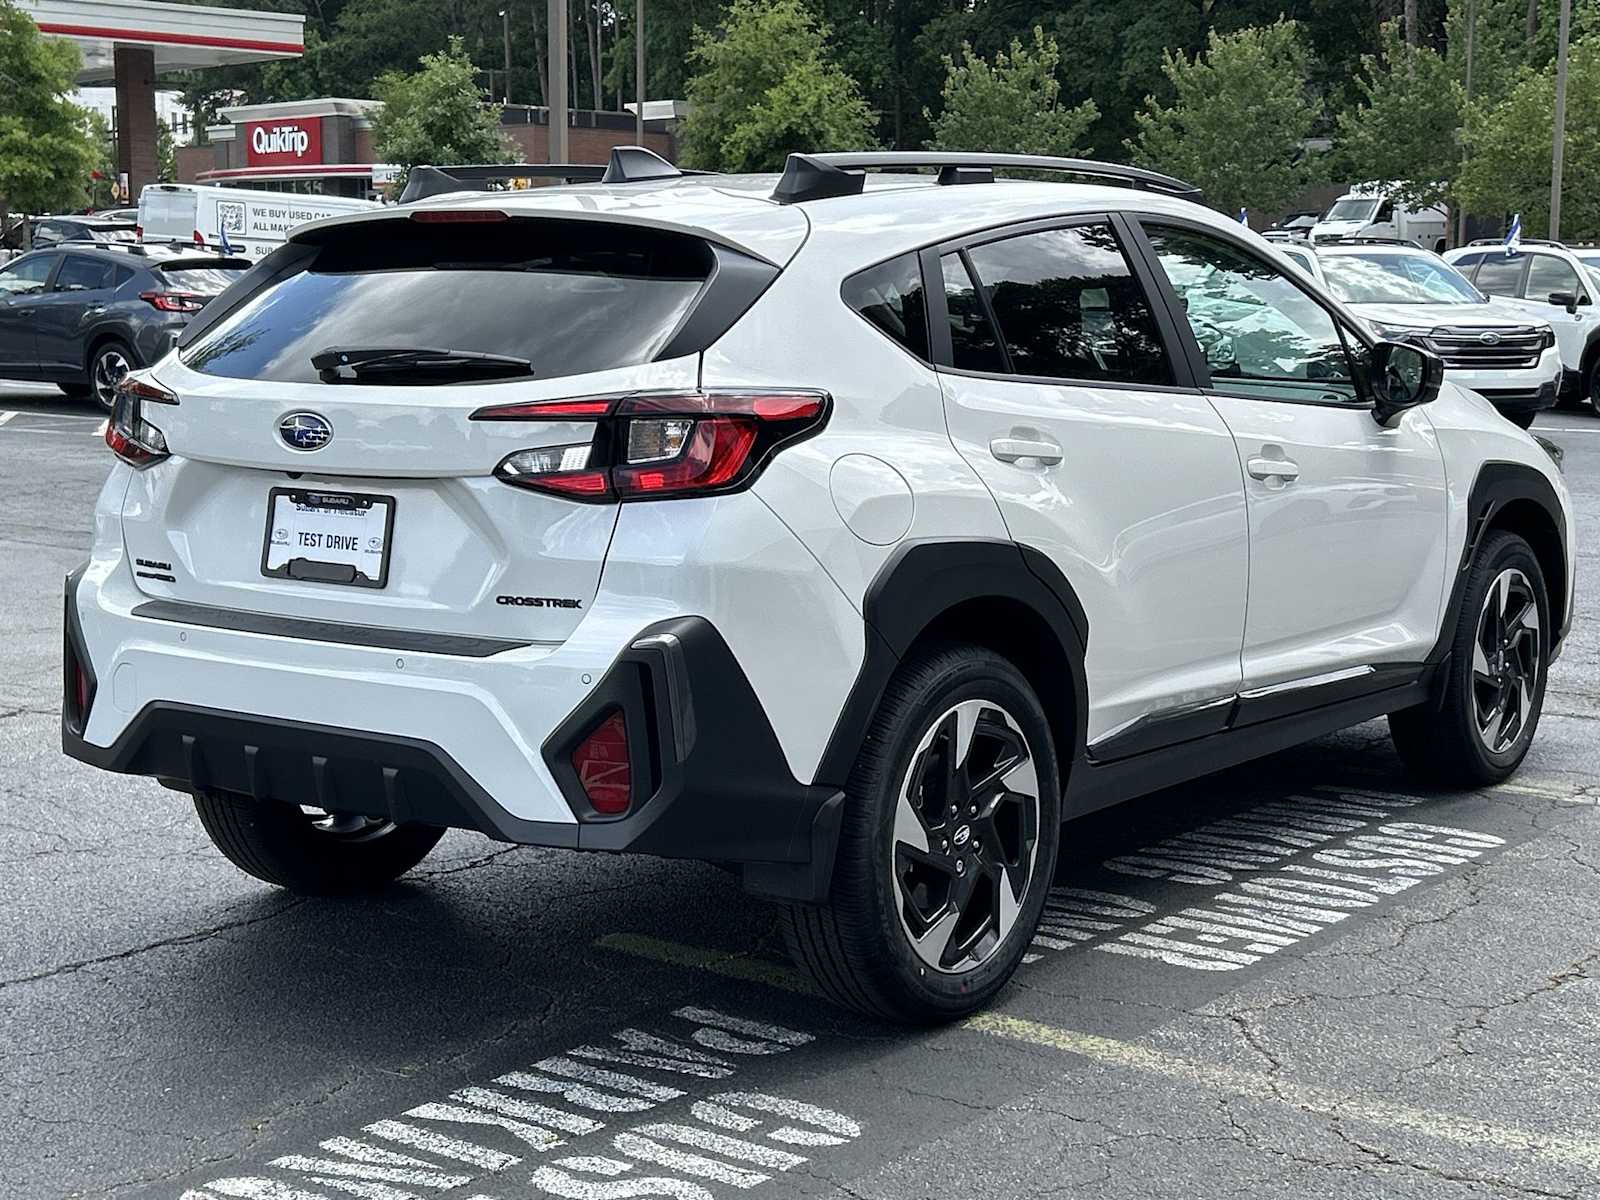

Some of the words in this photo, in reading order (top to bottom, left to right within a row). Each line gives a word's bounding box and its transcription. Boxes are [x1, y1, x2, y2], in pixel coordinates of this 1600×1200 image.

[253, 125, 308, 157] QuikTrip
[252, 208, 267, 217] WE
[269, 209, 287, 219] BUY
[289, 211, 312, 220] USED
[253, 222, 269, 231] ALL
[255, 246, 274, 255] SUB
[298, 532, 323, 547] TEST
[326, 535, 358, 551] DRIVE
[496, 595, 583, 609] CROSSTREK
[1093, 822, 1506, 971] CUSTOMER
[179, 1006, 815, 1200] PARKIN
[465, 1091, 861, 1200] CUS
